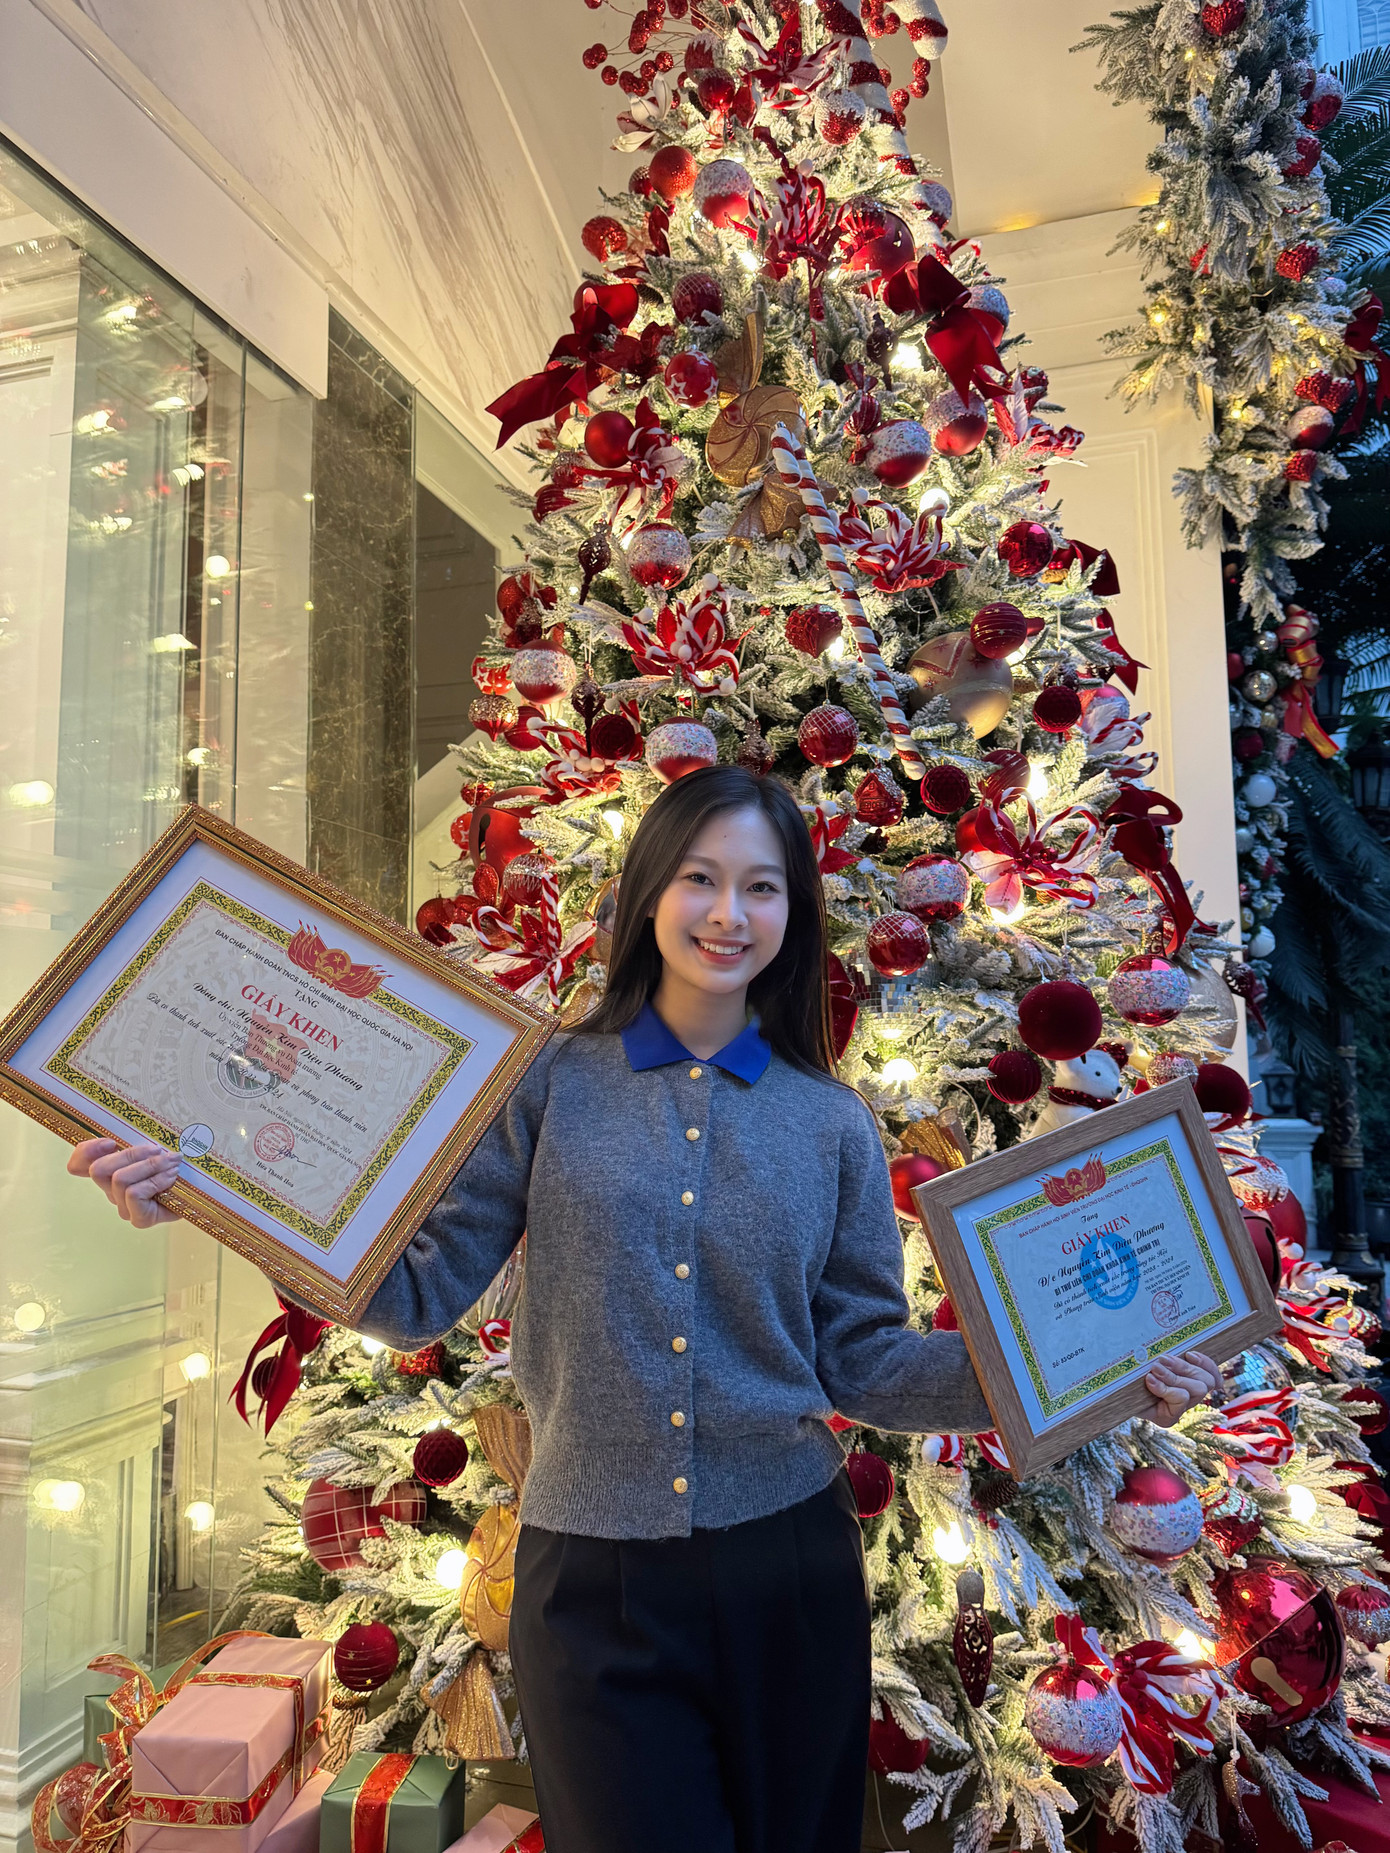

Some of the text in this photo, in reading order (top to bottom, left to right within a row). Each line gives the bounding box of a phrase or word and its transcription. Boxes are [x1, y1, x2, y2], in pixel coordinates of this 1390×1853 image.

[215, 929, 229, 940] BAN
[282, 969, 299, 982] TNCS
[320, 992, 336, 1005] MINH
[336, 1002, 348, 1012] ĐẠI
[347, 1009, 361, 1020] HỌC
[380, 1029, 391, 1038] GIA
[391, 1035, 401, 1044] HÀ
[241, 984, 343, 1052] GIẤY KHEN
[241, 1026, 254, 1037] Ban
[236, 1009, 273, 1035] Nguyễn
[278, 1033, 297, 1050] Kim
[324, 1062, 363, 1091] Phương
[275, 1059, 291, 1072] Kinh
[1061, 1214, 1130, 1255] GIẤY KHEN
[1093, 1248, 1111, 1260] Kim
[1133, 1222, 1165, 1242] Phương
